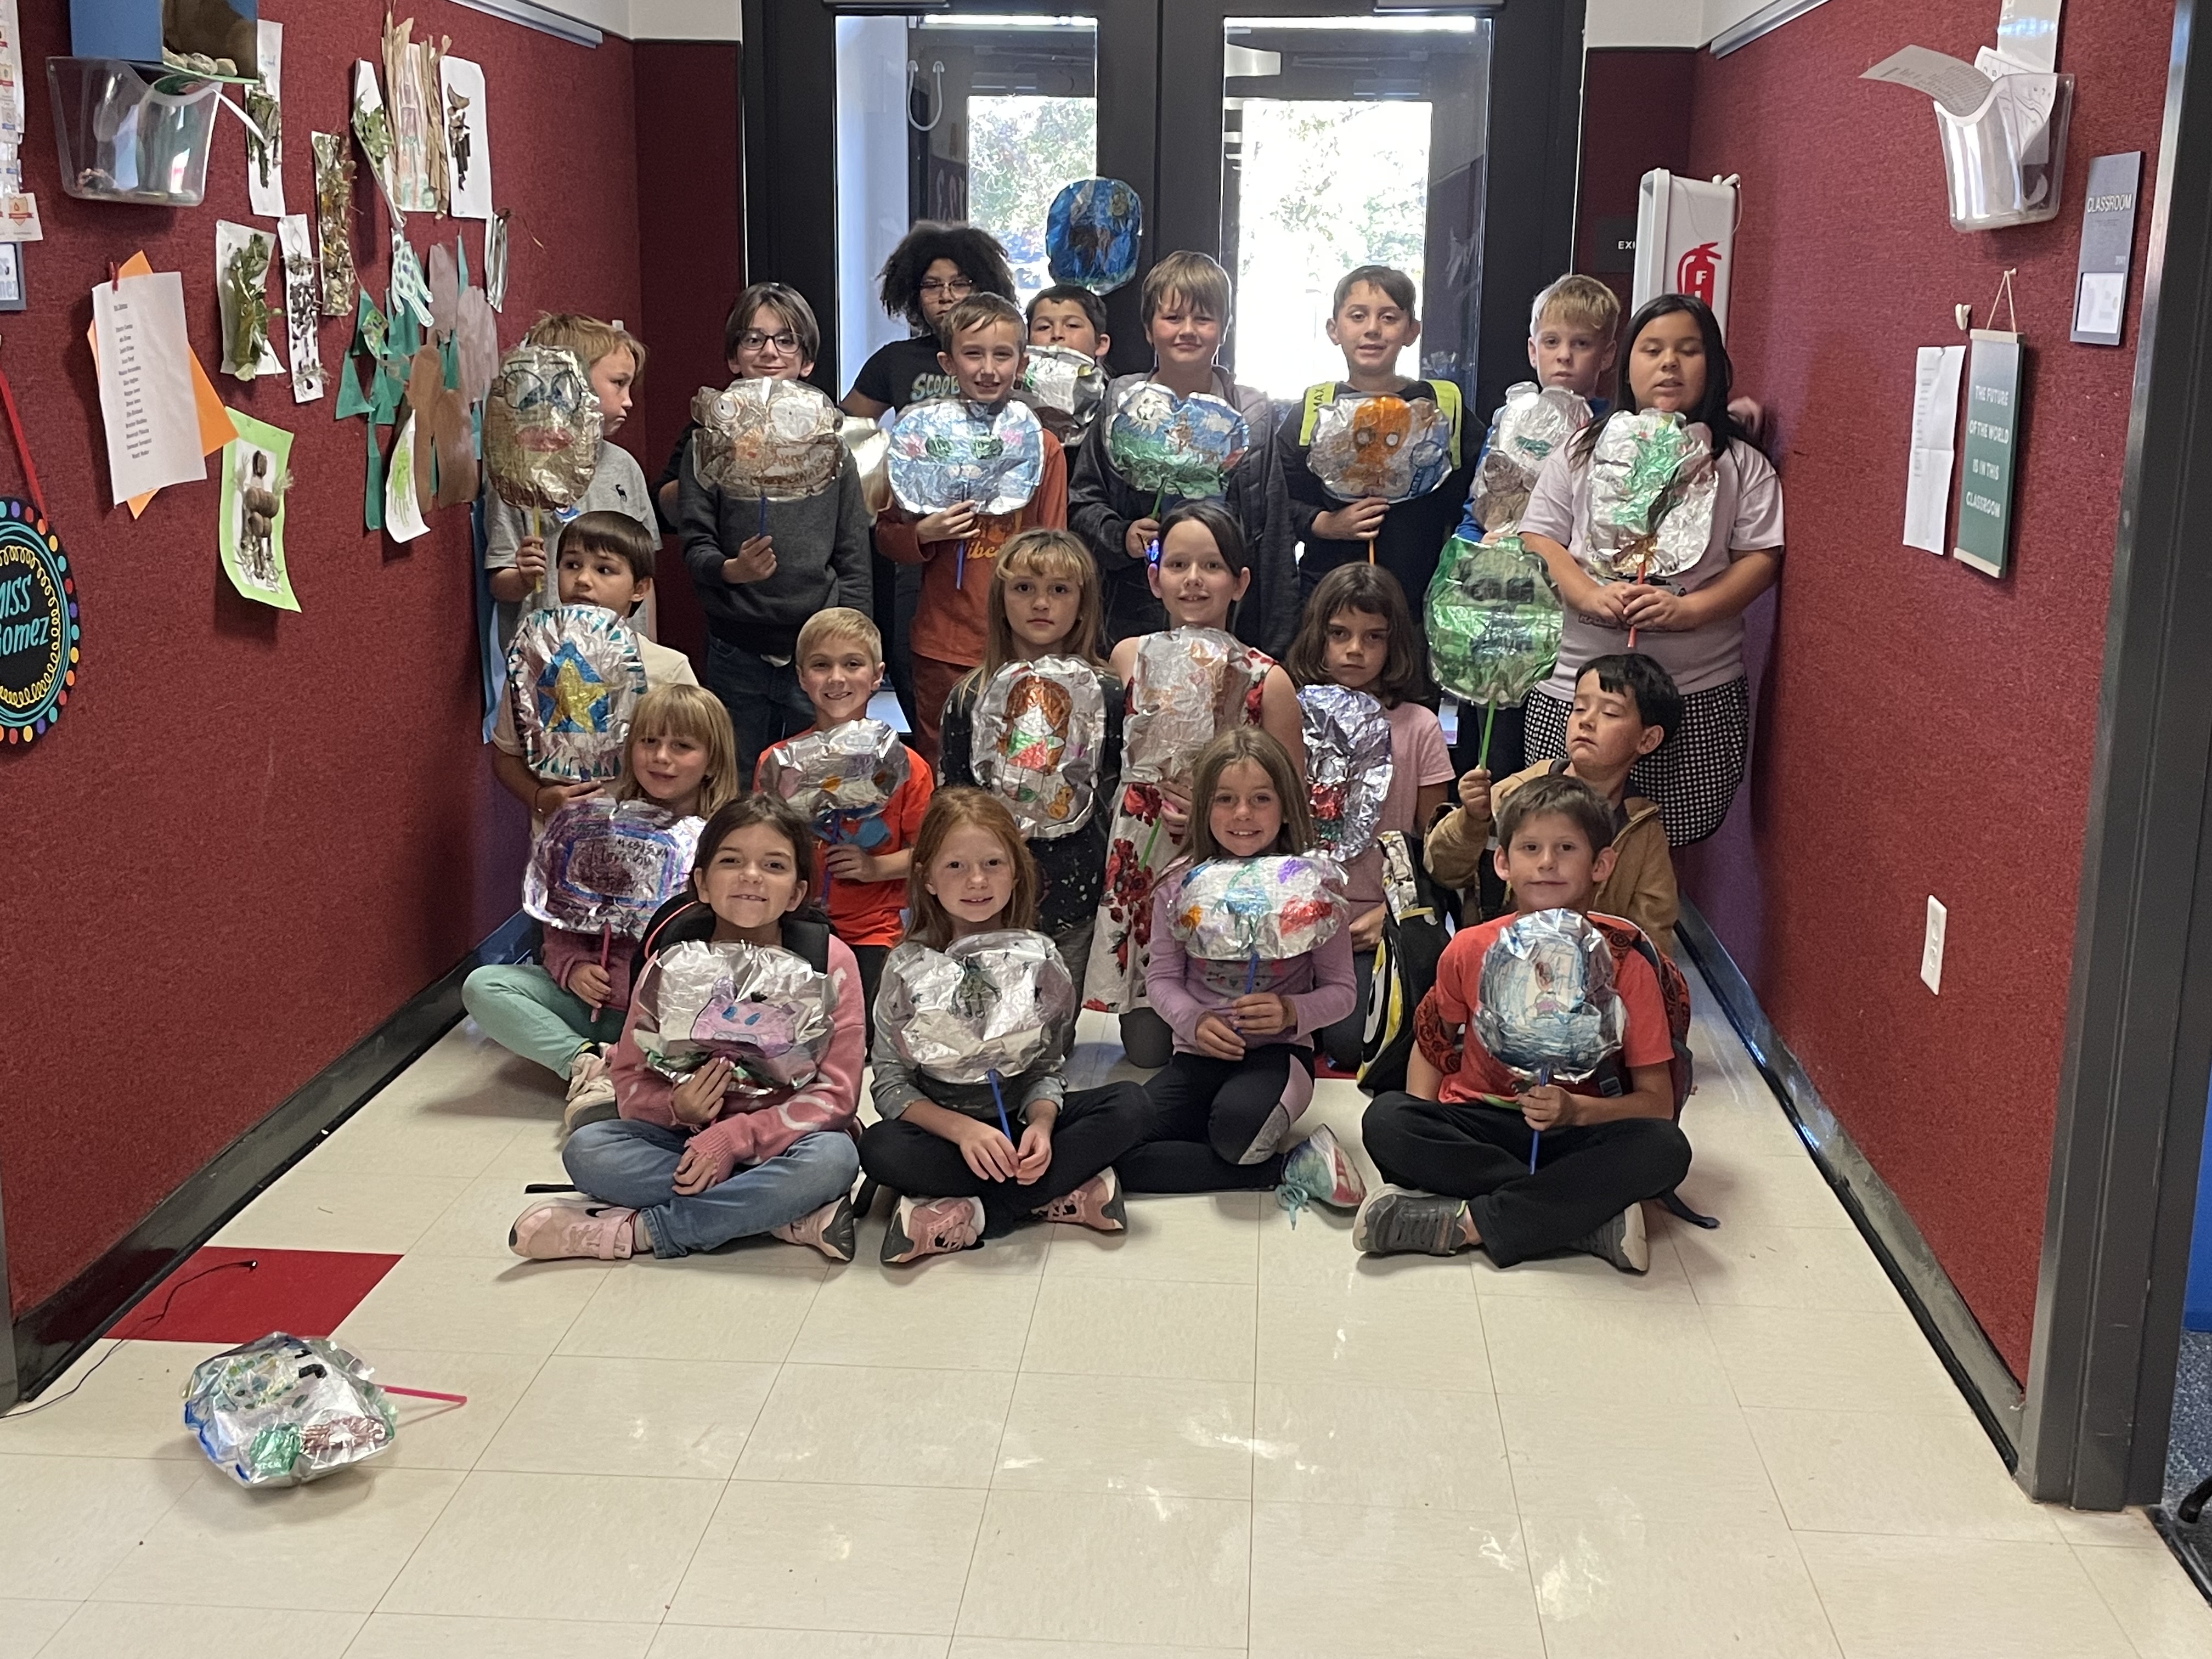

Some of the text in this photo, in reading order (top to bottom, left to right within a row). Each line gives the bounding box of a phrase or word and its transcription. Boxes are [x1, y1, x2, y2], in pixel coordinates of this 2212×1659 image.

[2087, 194, 2132, 213] CLASSROOM
[1618, 240, 1635, 250] EXI
[910, 373, 961, 401] SCOOB
[1976, 385, 2008, 407] THE FUTURE
[1969, 419, 2008, 444] OF THE WORLD
[1972, 459, 1999, 481] IS IN THIS
[1966, 491, 2000, 517] CLASSROOM
[0, 616, 49, 657] omez
